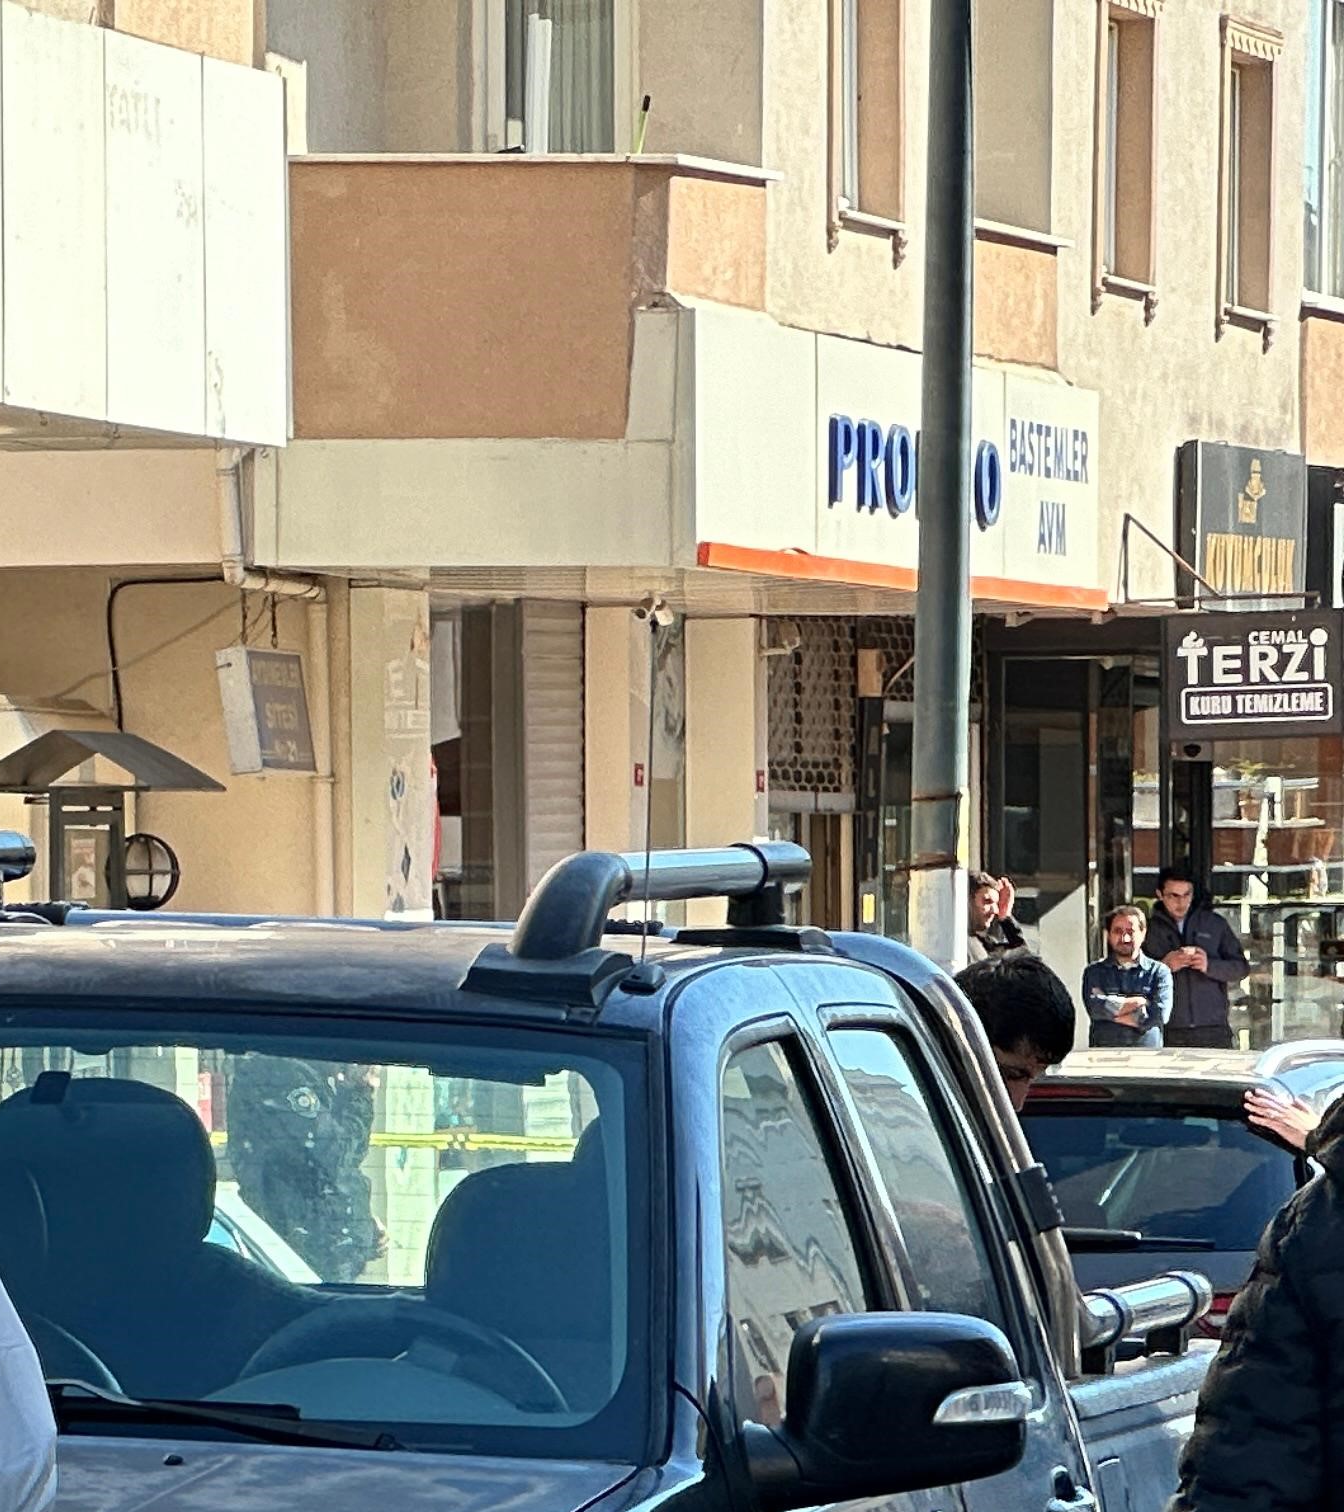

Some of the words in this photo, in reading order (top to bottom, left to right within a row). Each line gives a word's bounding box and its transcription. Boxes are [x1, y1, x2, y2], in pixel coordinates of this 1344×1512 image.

[828, 413, 1002, 532] PROO
[1037, 501, 1067, 556] AVM
[1248, 630, 1308, 645] CEMAL
[1190, 696, 1232, 716] KURU
